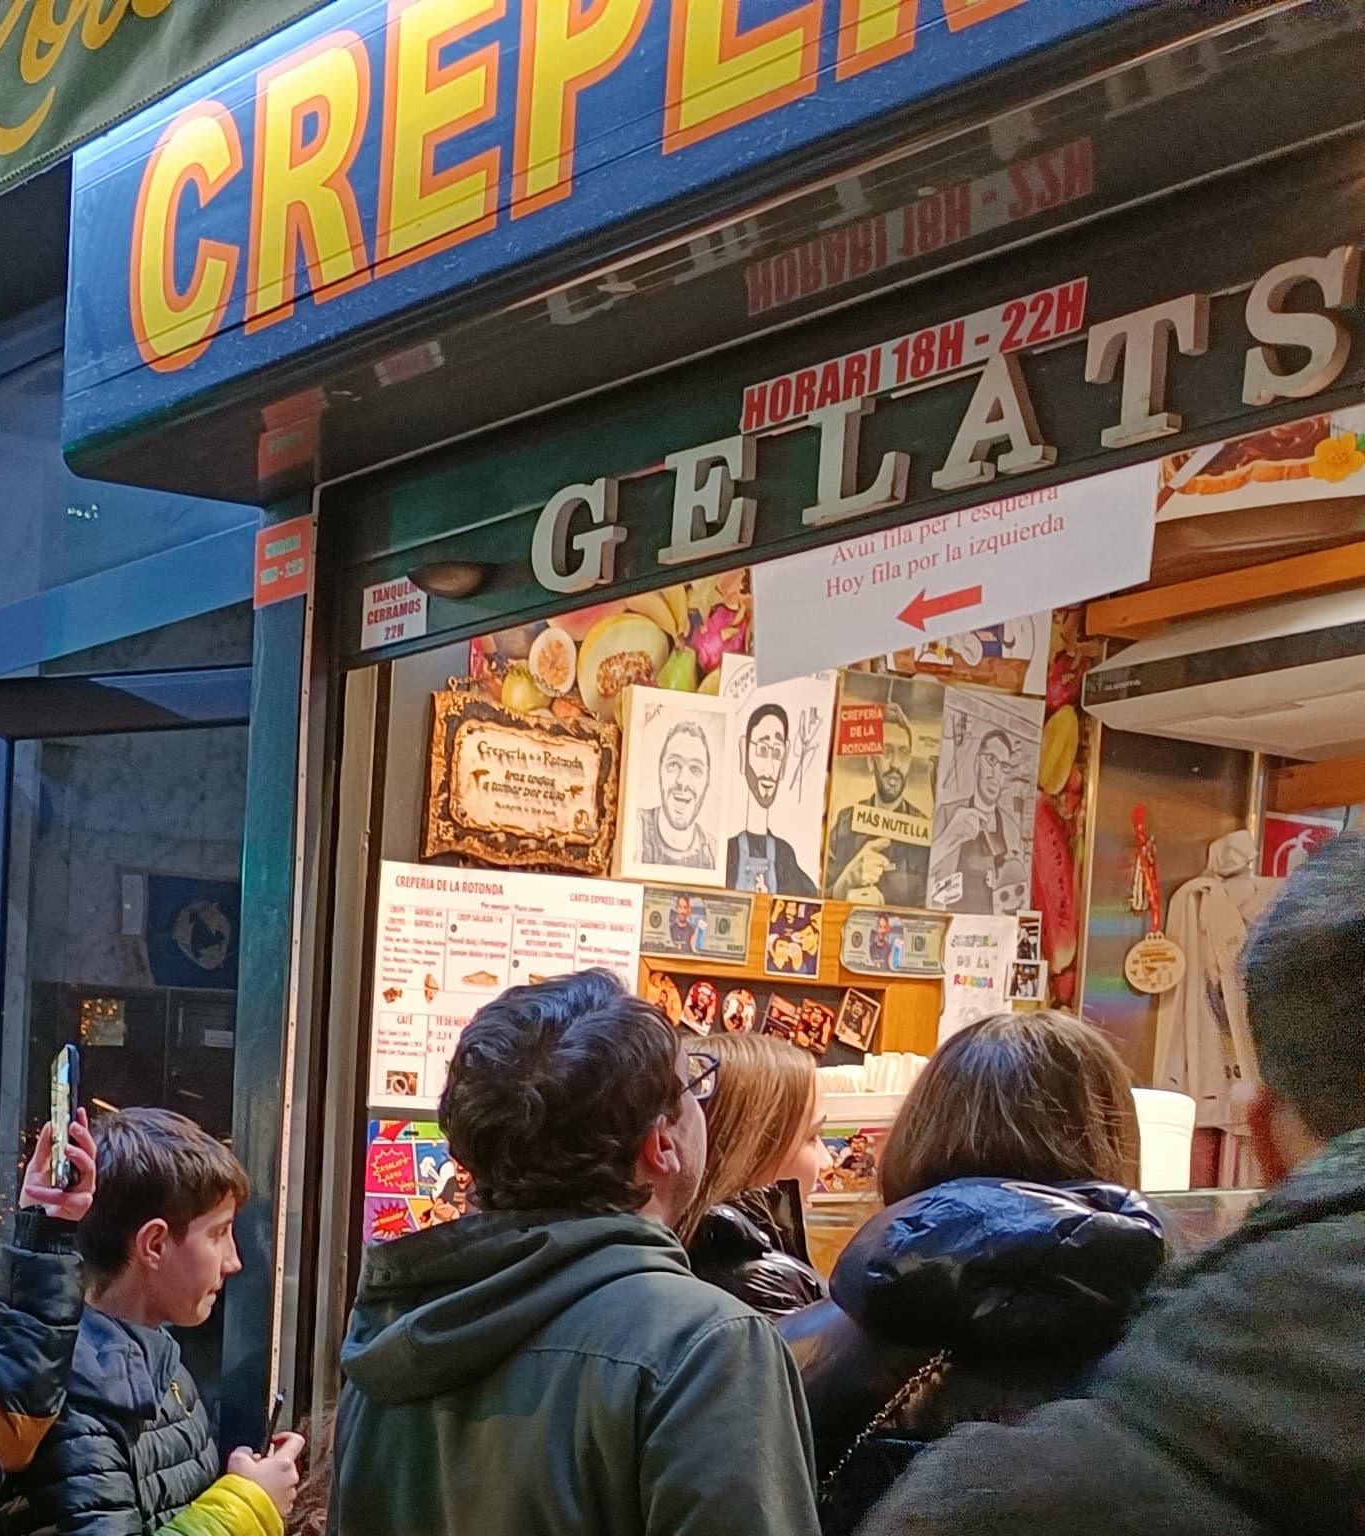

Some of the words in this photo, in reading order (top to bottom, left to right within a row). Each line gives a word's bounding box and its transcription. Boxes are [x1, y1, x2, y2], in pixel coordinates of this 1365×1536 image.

[128, 0, 1031, 374] CREP
[744, 346, 883, 432] HORARI
[891, 319, 966, 384] 18H
[999, 281, 1087, 354] 22H
[531, 244, 1364, 593] GELATS
[831, 537, 876, 565] Avui
[883, 525, 913, 552] fila
[919, 518, 950, 544] per
[971, 487, 1060, 525] esquerra
[826, 573, 866, 599] Hoy
[871, 562, 902, 586] fila
[908, 553, 939, 581] por
[946, 543, 963, 563] la
[969, 513, 1066, 556] izquierda
[366, 598, 422, 626] CERRAMOS
[384, 622, 405, 641] 22H
[849, 726, 863, 738] DE
[864, 725, 875, 737] LA
[841, 741, 883, 754] ROTONDA
[856, 809, 881, 828] MÁS
[881, 818, 930, 840] NUTELLA
[395, 875, 435, 891] CREPERIA
[436, 879, 447, 892] DE
[449, 881, 460, 893] LA
[462, 881, 504, 896] ROTONDA
